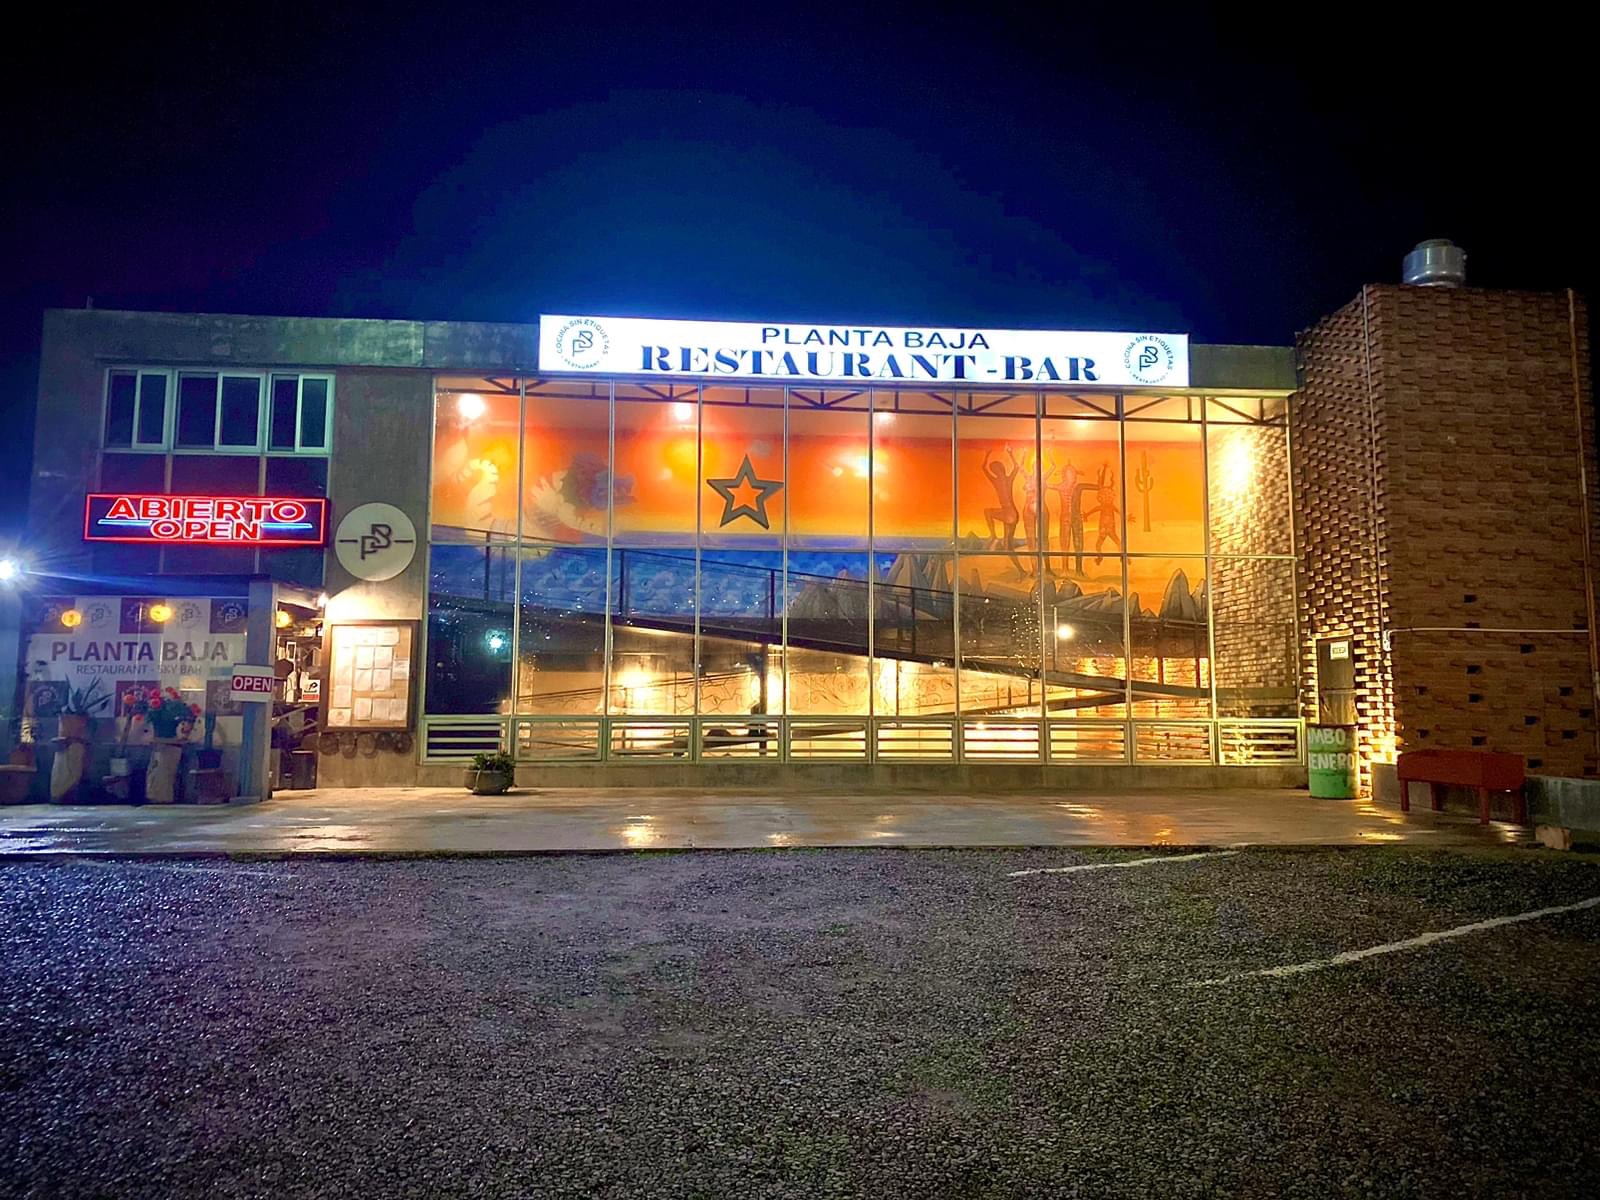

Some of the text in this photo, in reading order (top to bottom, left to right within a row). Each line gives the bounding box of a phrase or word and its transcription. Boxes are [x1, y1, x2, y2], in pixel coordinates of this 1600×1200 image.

[556, 323, 570, 354] COCINA
[569, 318, 583, 327] SIN
[762, 327, 990, 350] PLANTA BAJA
[640, 345, 976, 380] RESTAURANT
[106, 496, 307, 523] ABIERTO
[150, 520, 262, 541] OPEN
[51, 641, 228, 662] PLANTA BAJA
[76, 664, 148, 675] RESTAURANT
[232, 675, 273, 692] OPEN
[1308, 752, 1355, 770] ENERO
